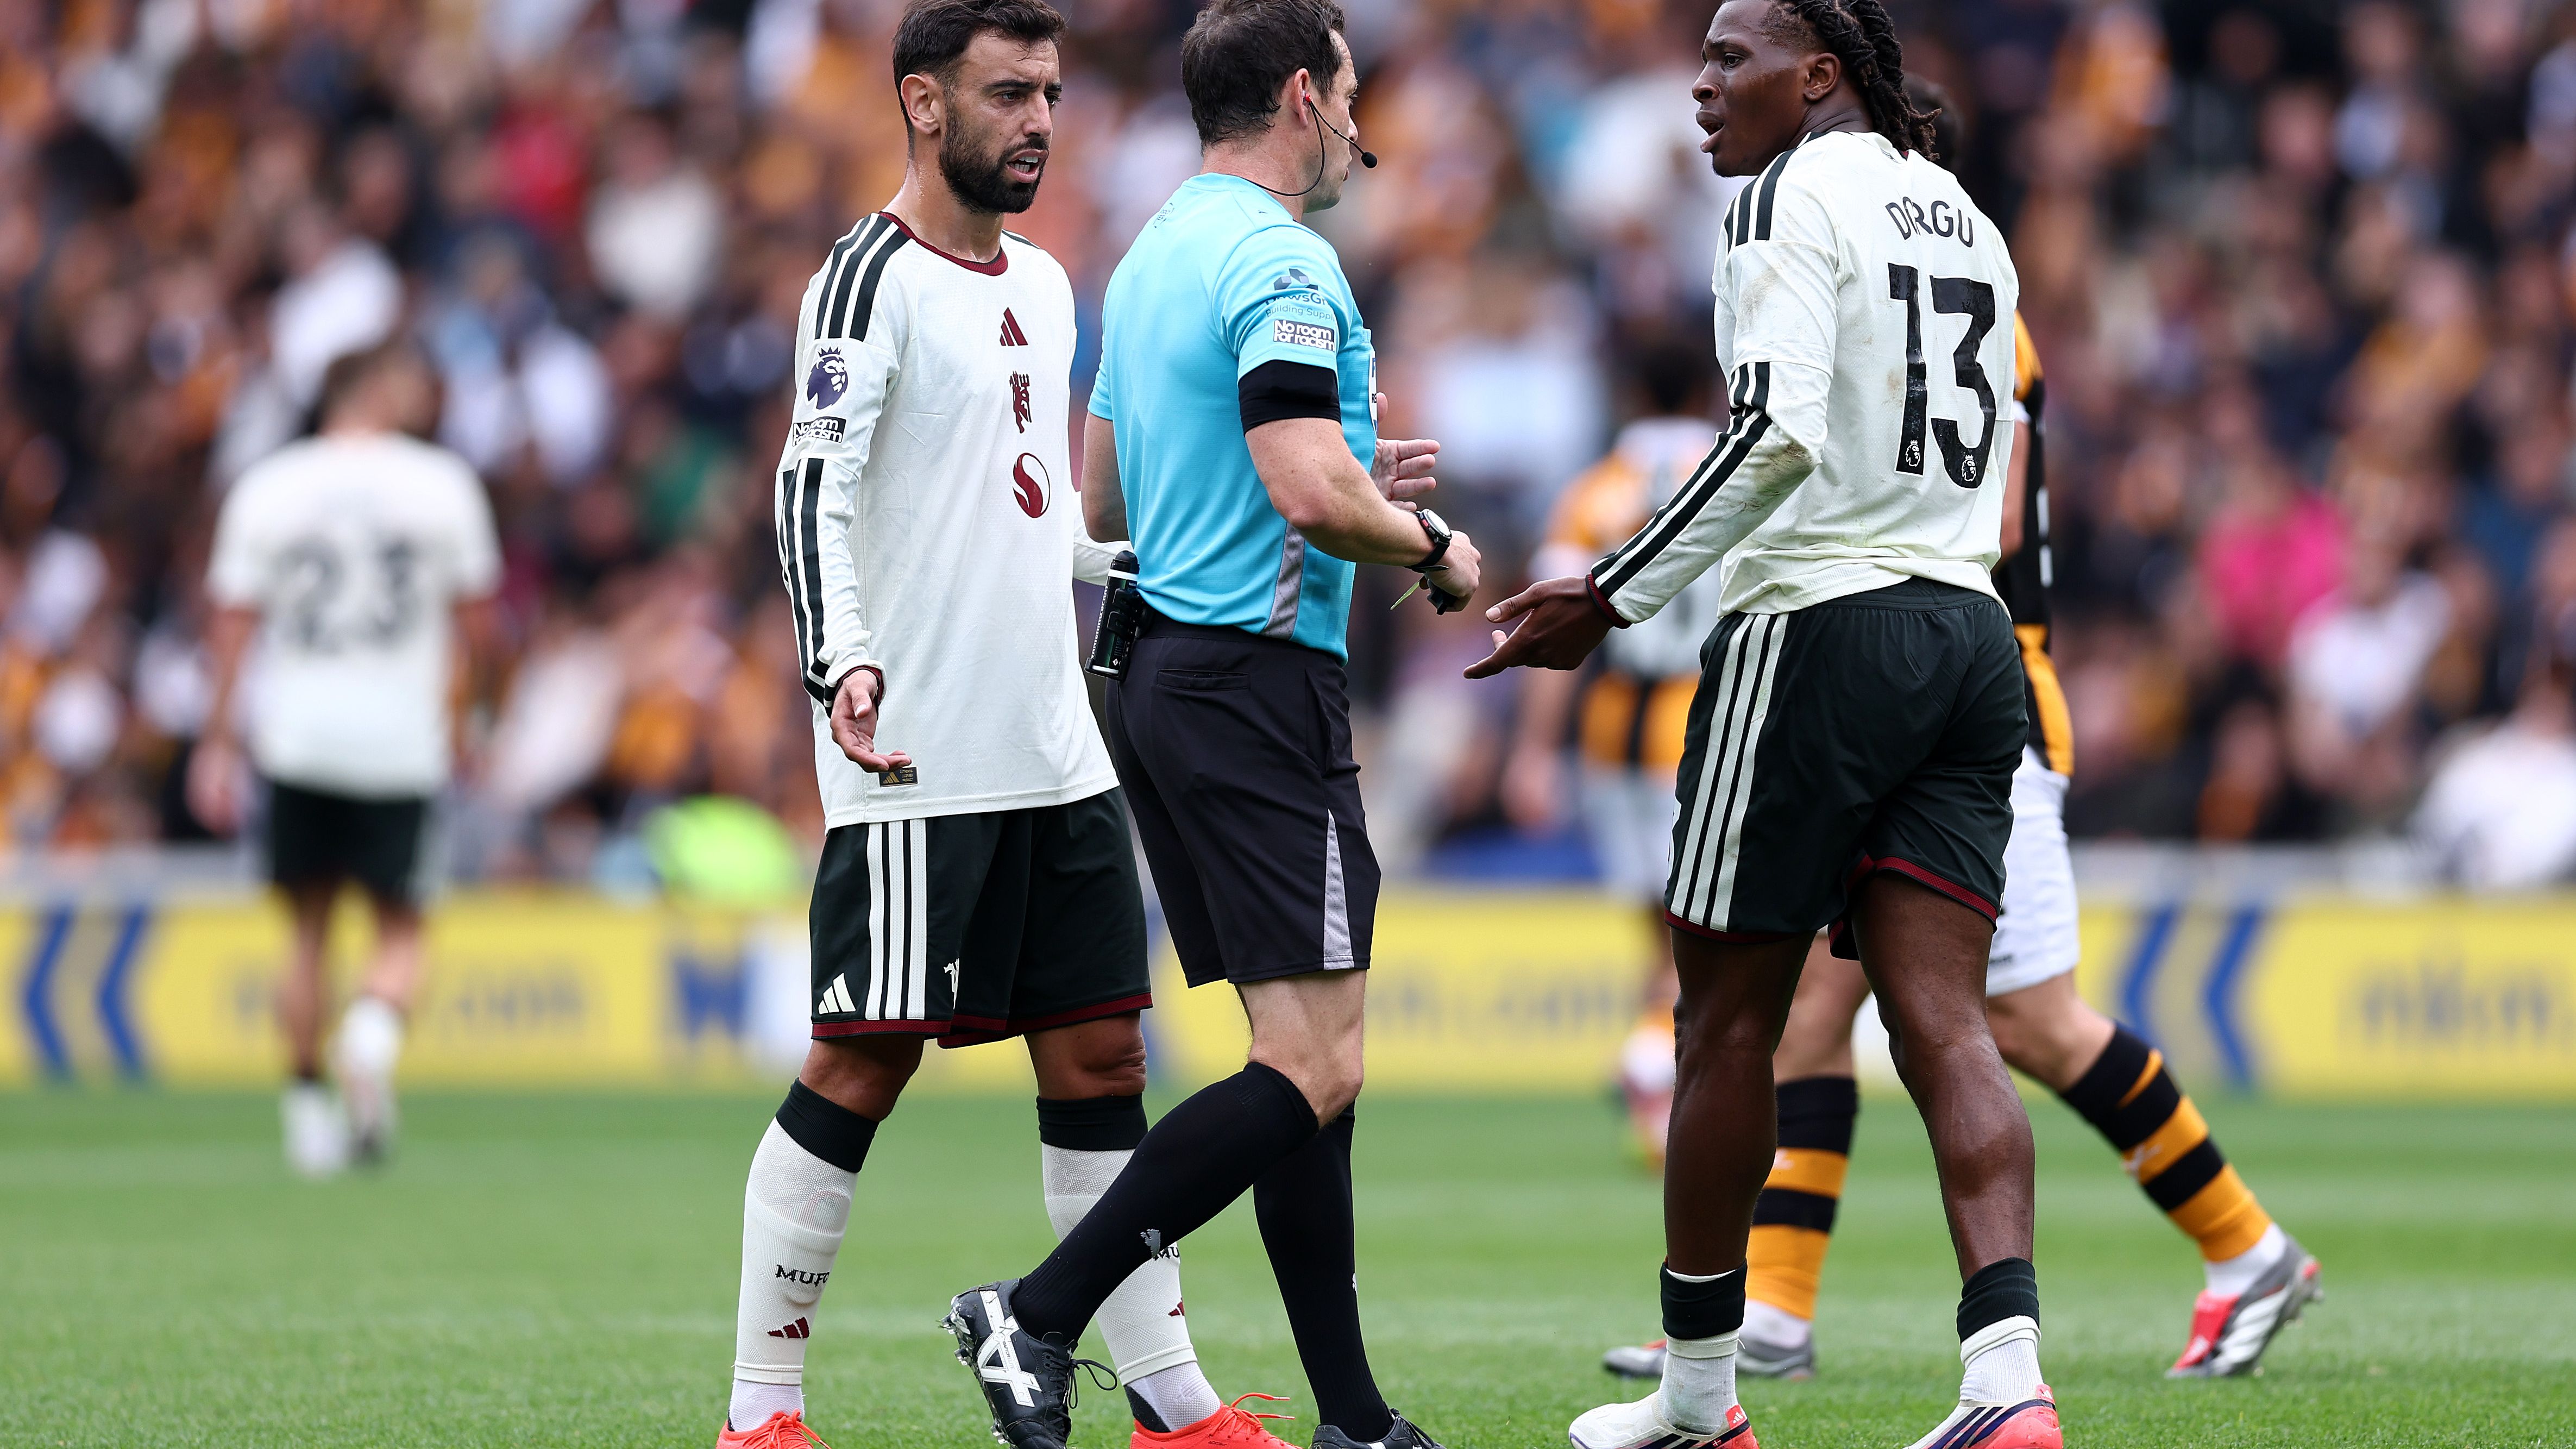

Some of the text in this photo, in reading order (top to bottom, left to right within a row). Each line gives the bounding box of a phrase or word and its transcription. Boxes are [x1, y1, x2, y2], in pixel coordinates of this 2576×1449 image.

[1266, 305, 1303, 317] Building
[1274, 320, 1331, 340] No room
[1274, 330, 1335, 352] for racism
[1887, 262, 1996, 489] 13
[793, 419, 839, 435] No oom
[806, 428, 843, 442] acism
[775, 1264, 830, 1287] MUFC
